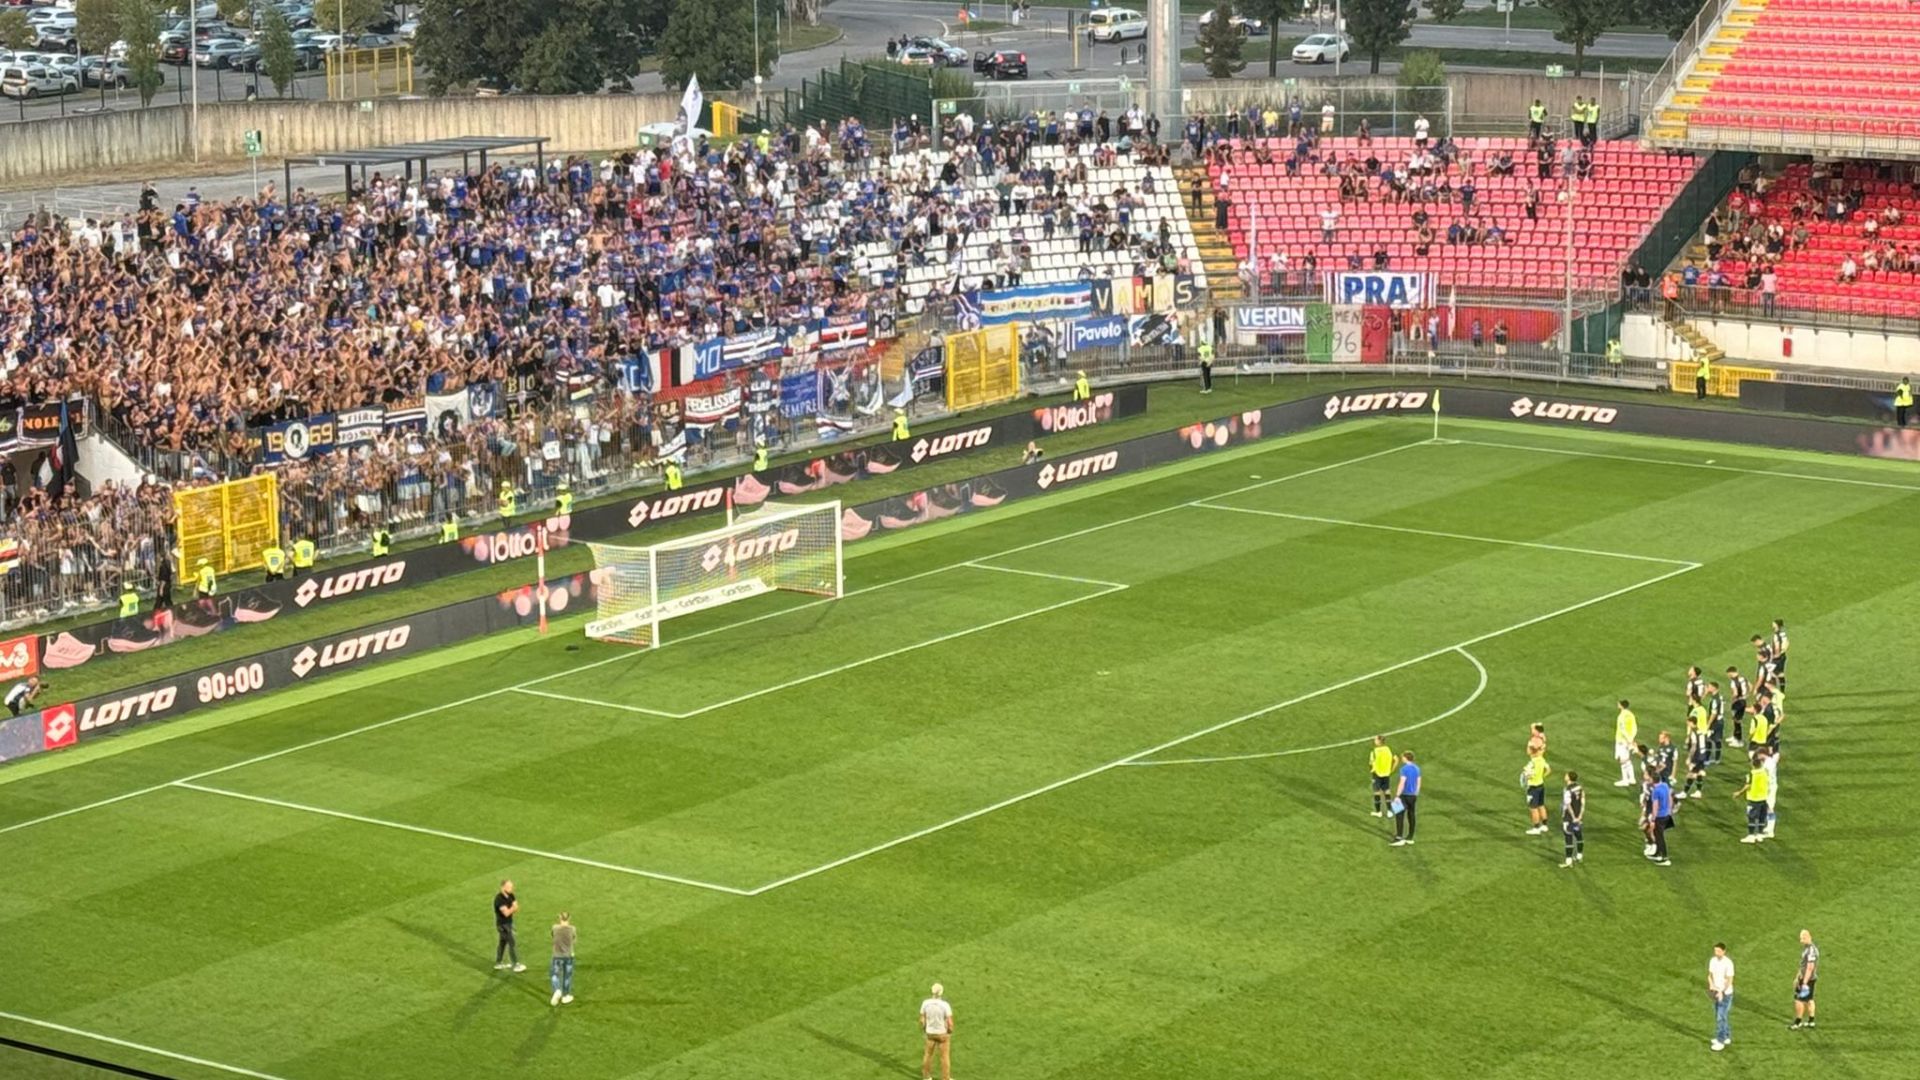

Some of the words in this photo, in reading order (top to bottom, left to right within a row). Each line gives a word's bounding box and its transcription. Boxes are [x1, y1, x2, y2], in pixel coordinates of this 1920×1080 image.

[1344, 276, 1416, 306] PRA'
[1052, 402, 1098, 433] lotto.it
[1340, 390, 1428, 414] LOTTO
[1534, 402, 1618, 424] LOTTO
[929, 426, 993, 457] LOTTO
[1056, 451, 1118, 482] LOTTO
[650, 487, 723, 521] LOTTO
[489, 524, 550, 564] lotto.it
[725, 529, 799, 566] LOTTO
[319, 561, 407, 599] LOTTO
[318, 624, 411, 668] LOTTO
[197, 663, 265, 703] 90:00
[79, 685, 178, 732] LOTTO
